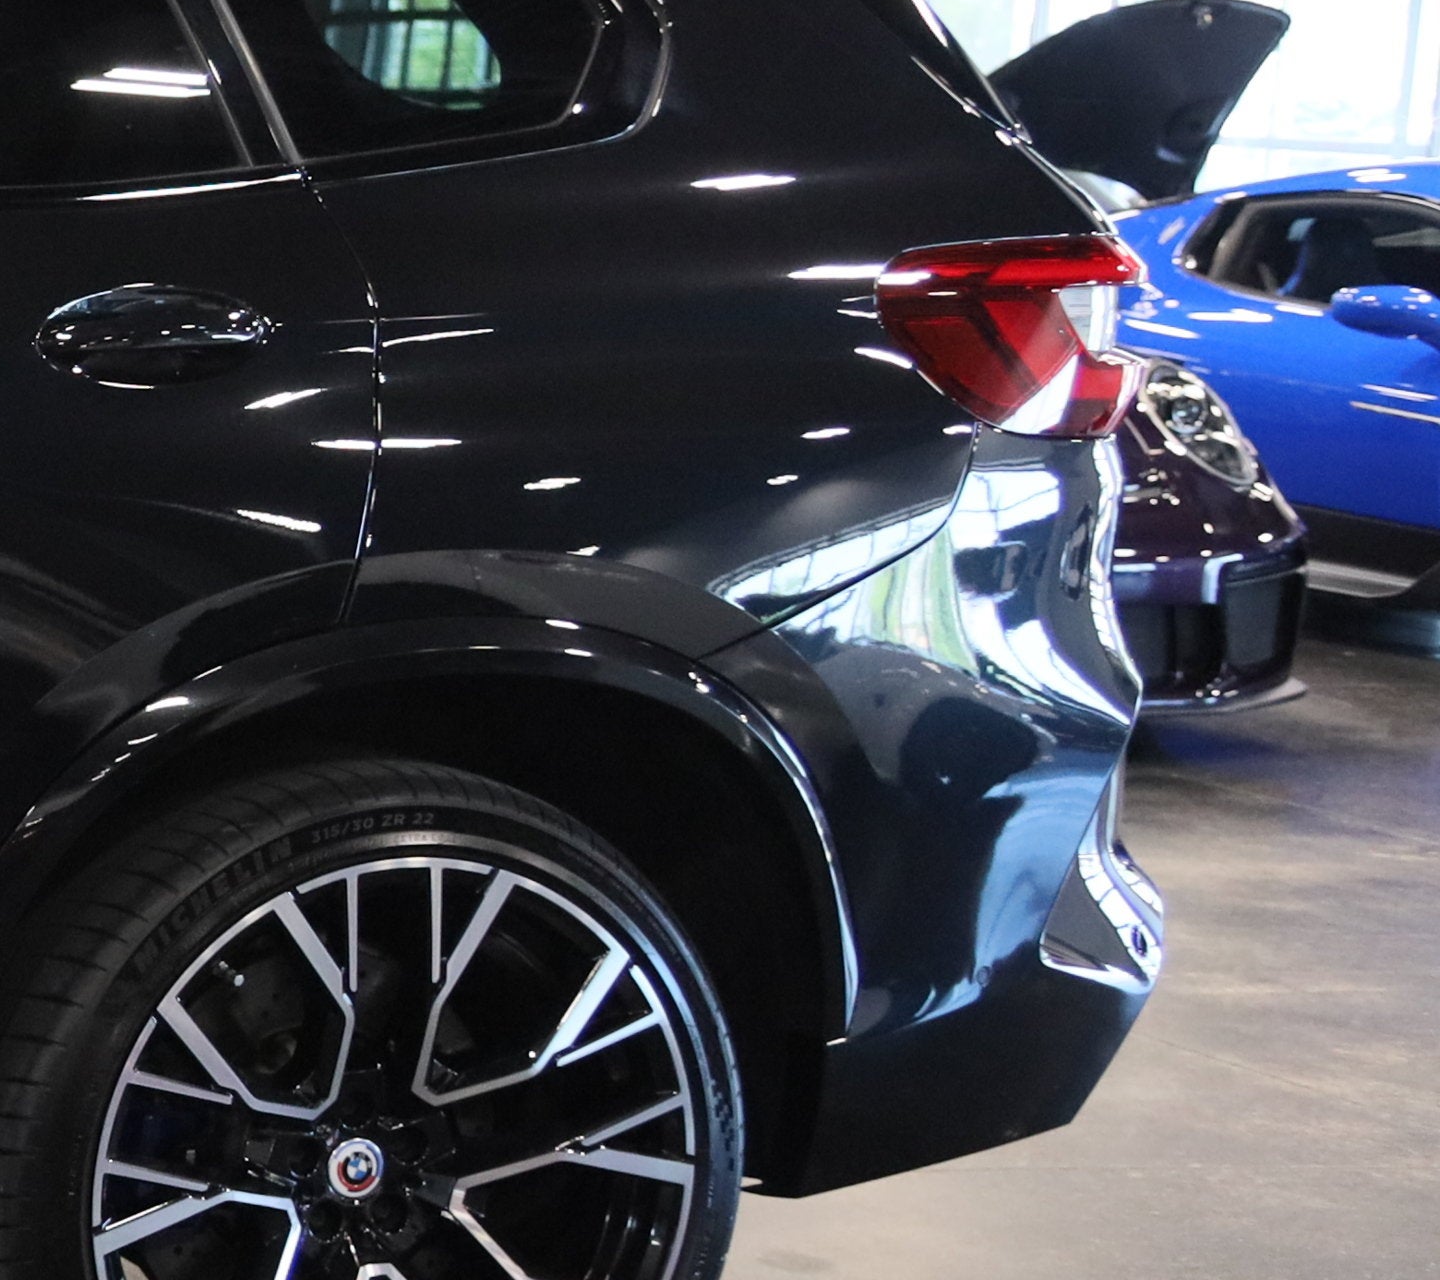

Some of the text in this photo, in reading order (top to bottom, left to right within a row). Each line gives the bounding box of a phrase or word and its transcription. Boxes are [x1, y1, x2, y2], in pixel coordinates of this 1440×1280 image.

[381, 813, 405, 828] ZR
[413, 812, 435, 826] 22
[132, 836, 293, 975] MICHELIN
